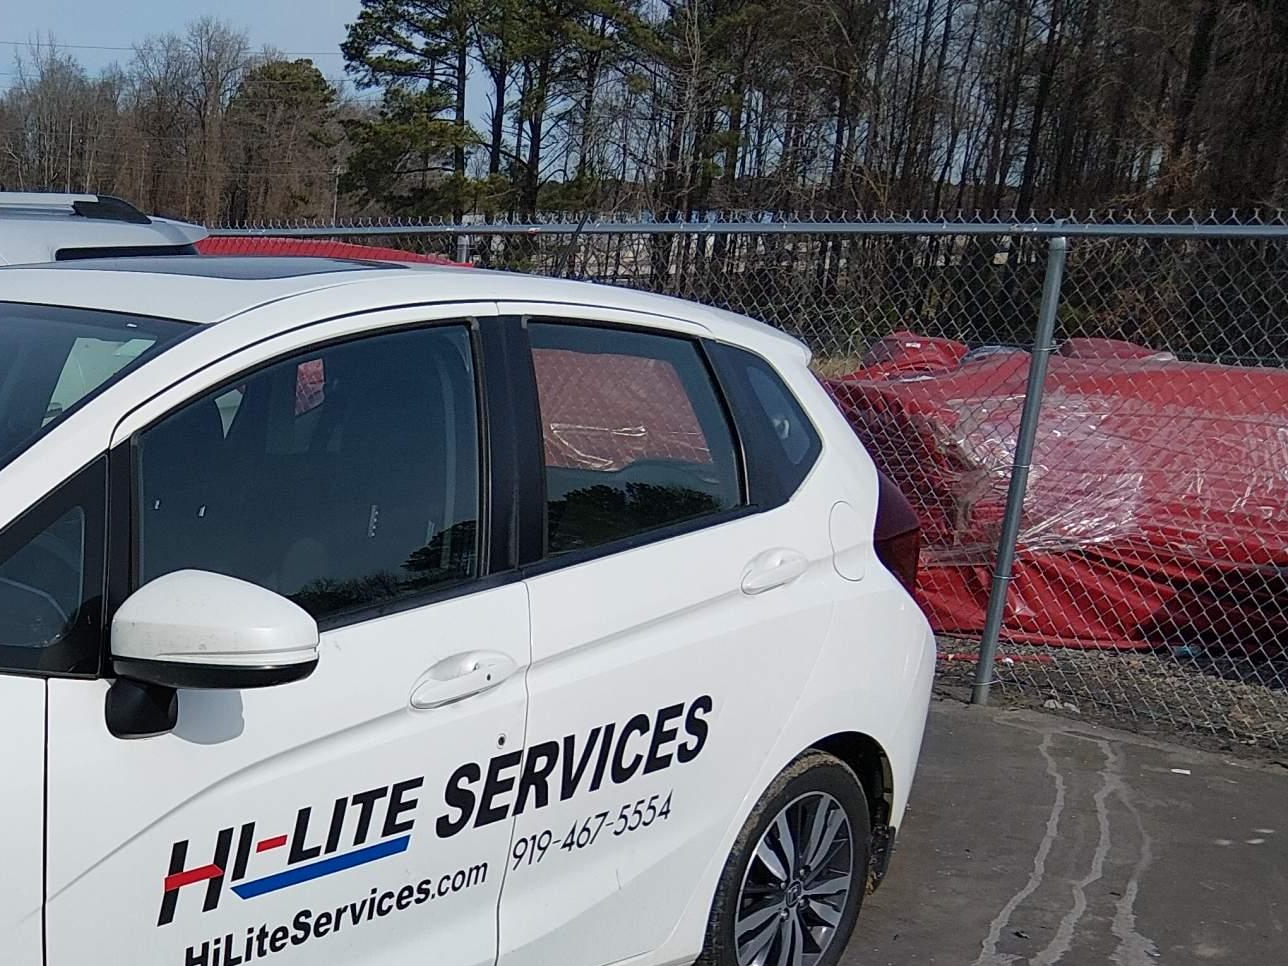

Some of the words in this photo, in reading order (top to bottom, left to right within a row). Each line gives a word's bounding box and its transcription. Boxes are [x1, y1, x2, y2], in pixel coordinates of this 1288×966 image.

[157, 777, 424, 926] HI-LITE
[436, 695, 713, 839] SERVICES
[512, 789, 674, 872] 919-467-5554
